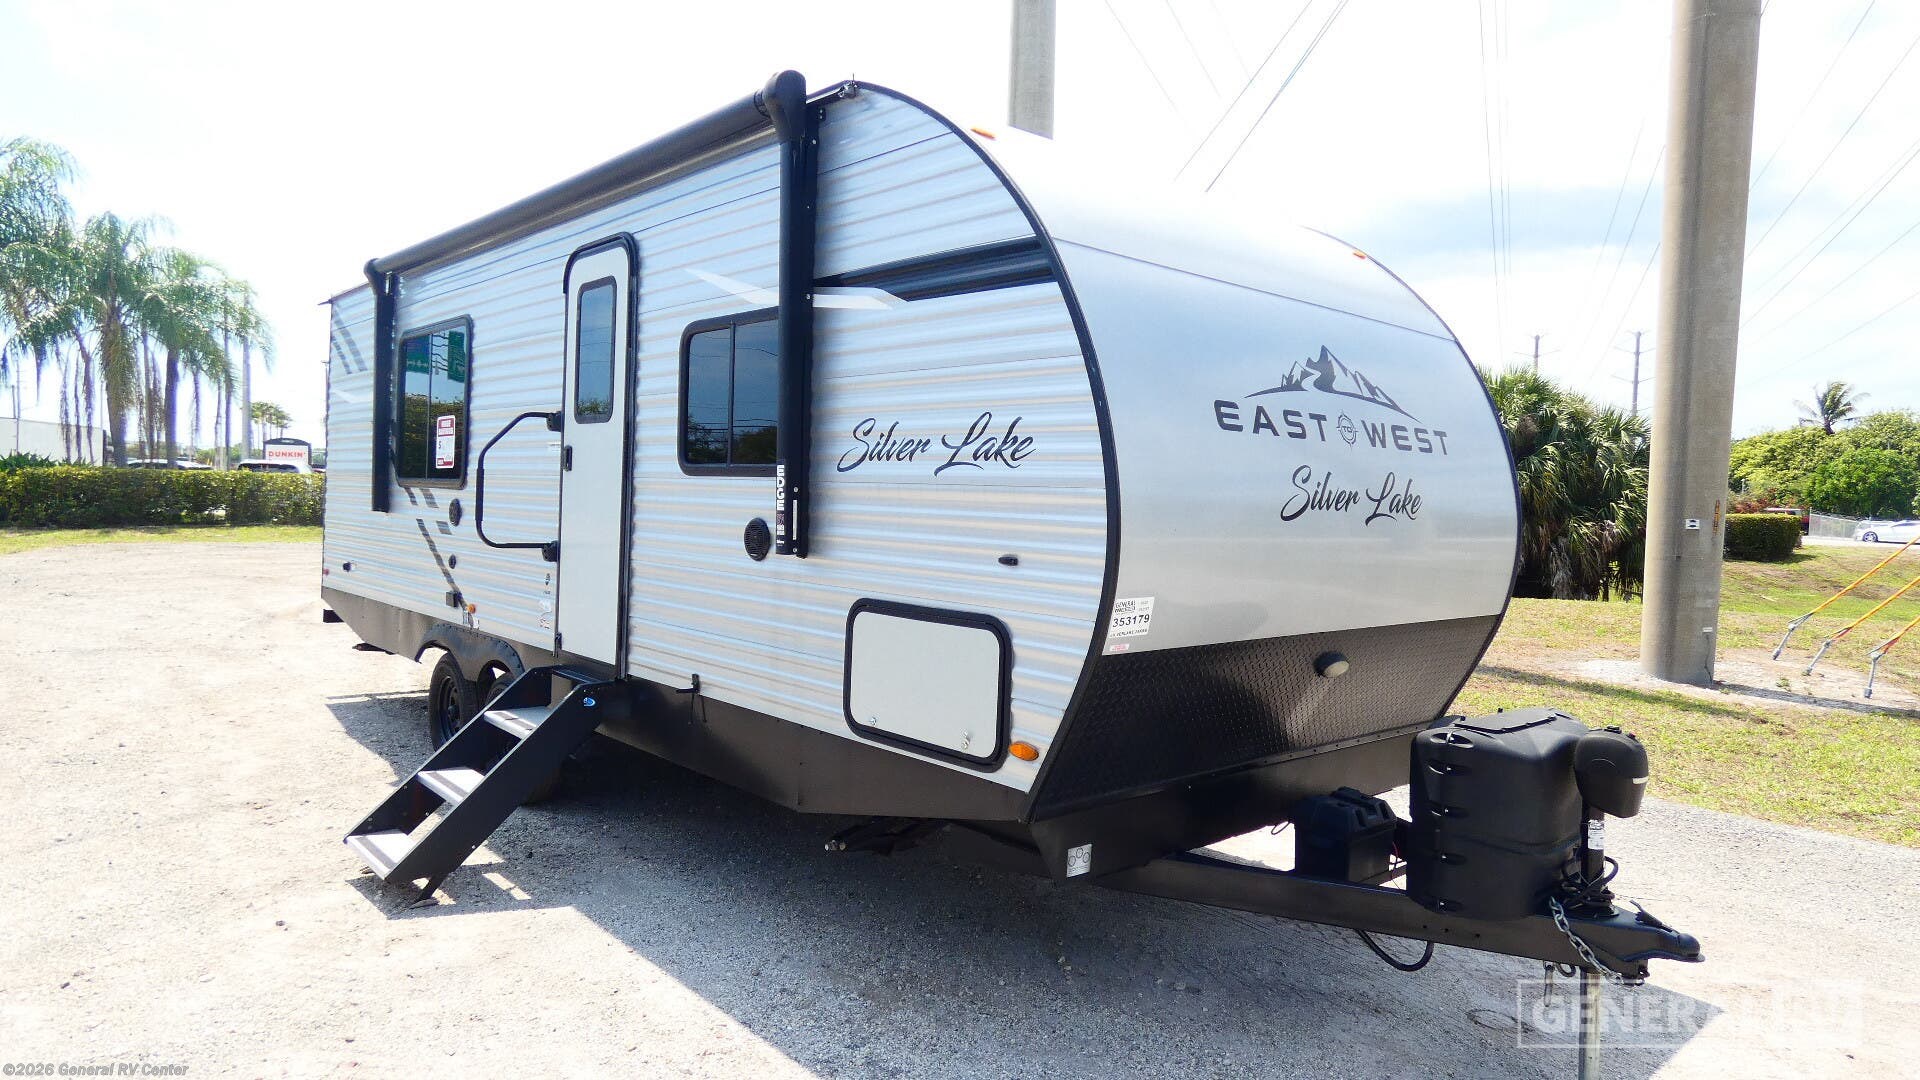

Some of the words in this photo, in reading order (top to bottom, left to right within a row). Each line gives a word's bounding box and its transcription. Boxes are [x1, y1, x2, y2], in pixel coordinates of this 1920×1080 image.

[268, 450, 306, 458] DUNKIN'
[836, 417, 933, 473] Silver
[933, 411, 1038, 478] Lake
[1213, 399, 1328, 442] EAST
[1361, 419, 1449, 456] WEST
[1280, 464, 1360, 522] Silver
[1364, 471, 1423, 527] Lake
[1112, 613, 1151, 628] 353179
